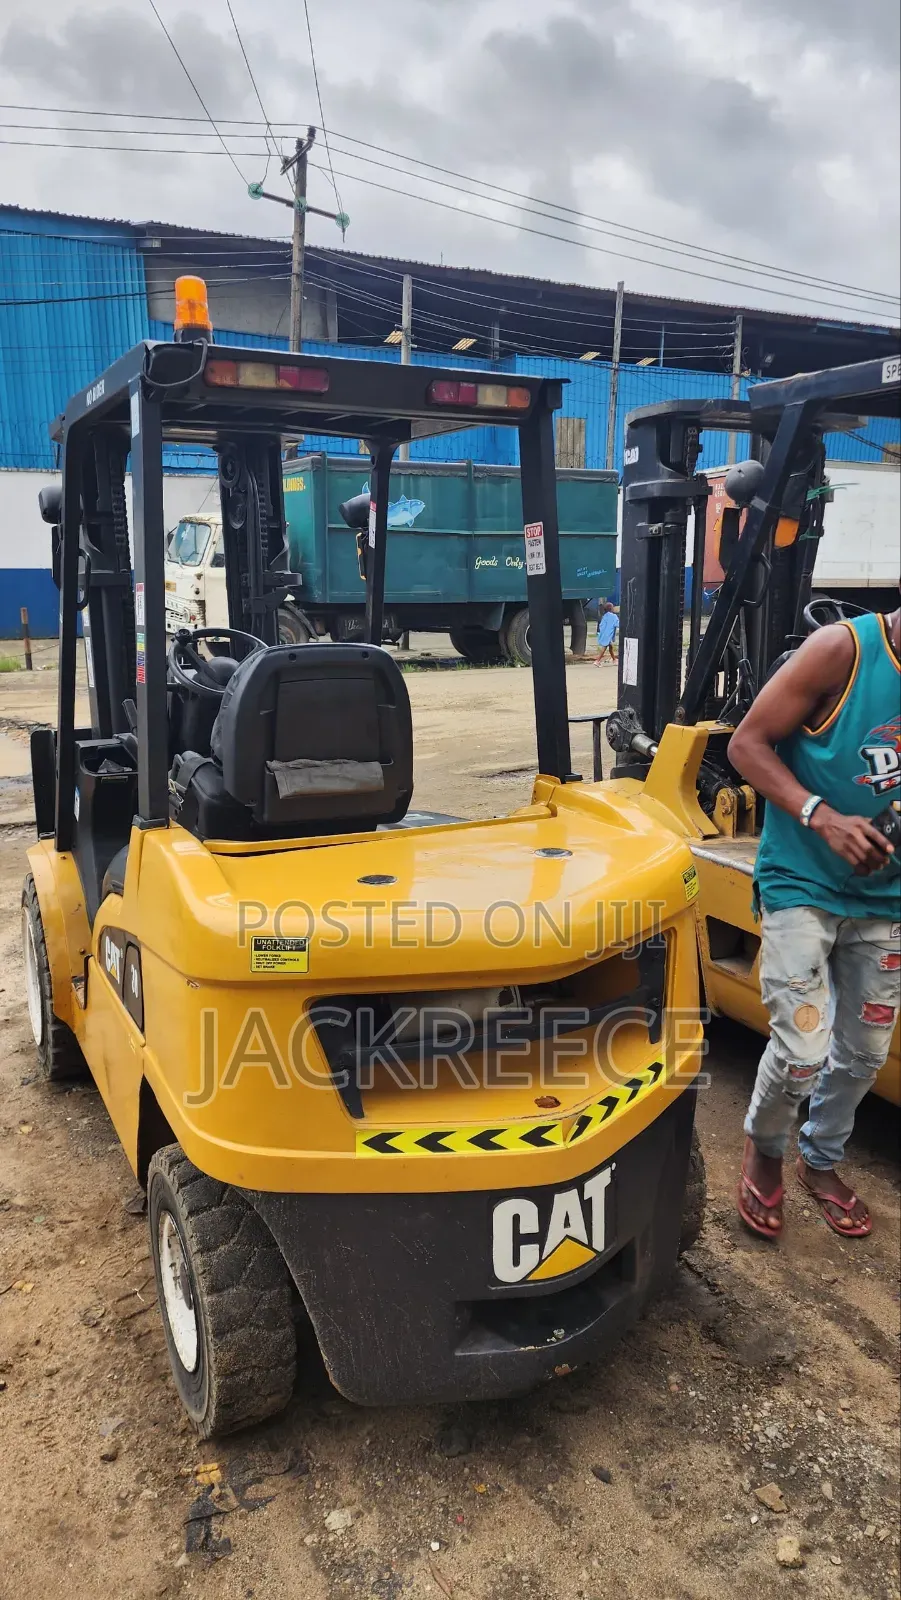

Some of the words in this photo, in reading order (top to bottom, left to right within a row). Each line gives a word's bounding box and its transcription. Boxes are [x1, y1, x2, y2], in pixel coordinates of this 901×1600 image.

[625, 446, 639, 465] CAT
[526, 525, 542, 538] STOP
[475, 556, 498, 569] Goods
[105, 935, 121, 985] CAT
[492, 1166, 613, 1283] CAT
